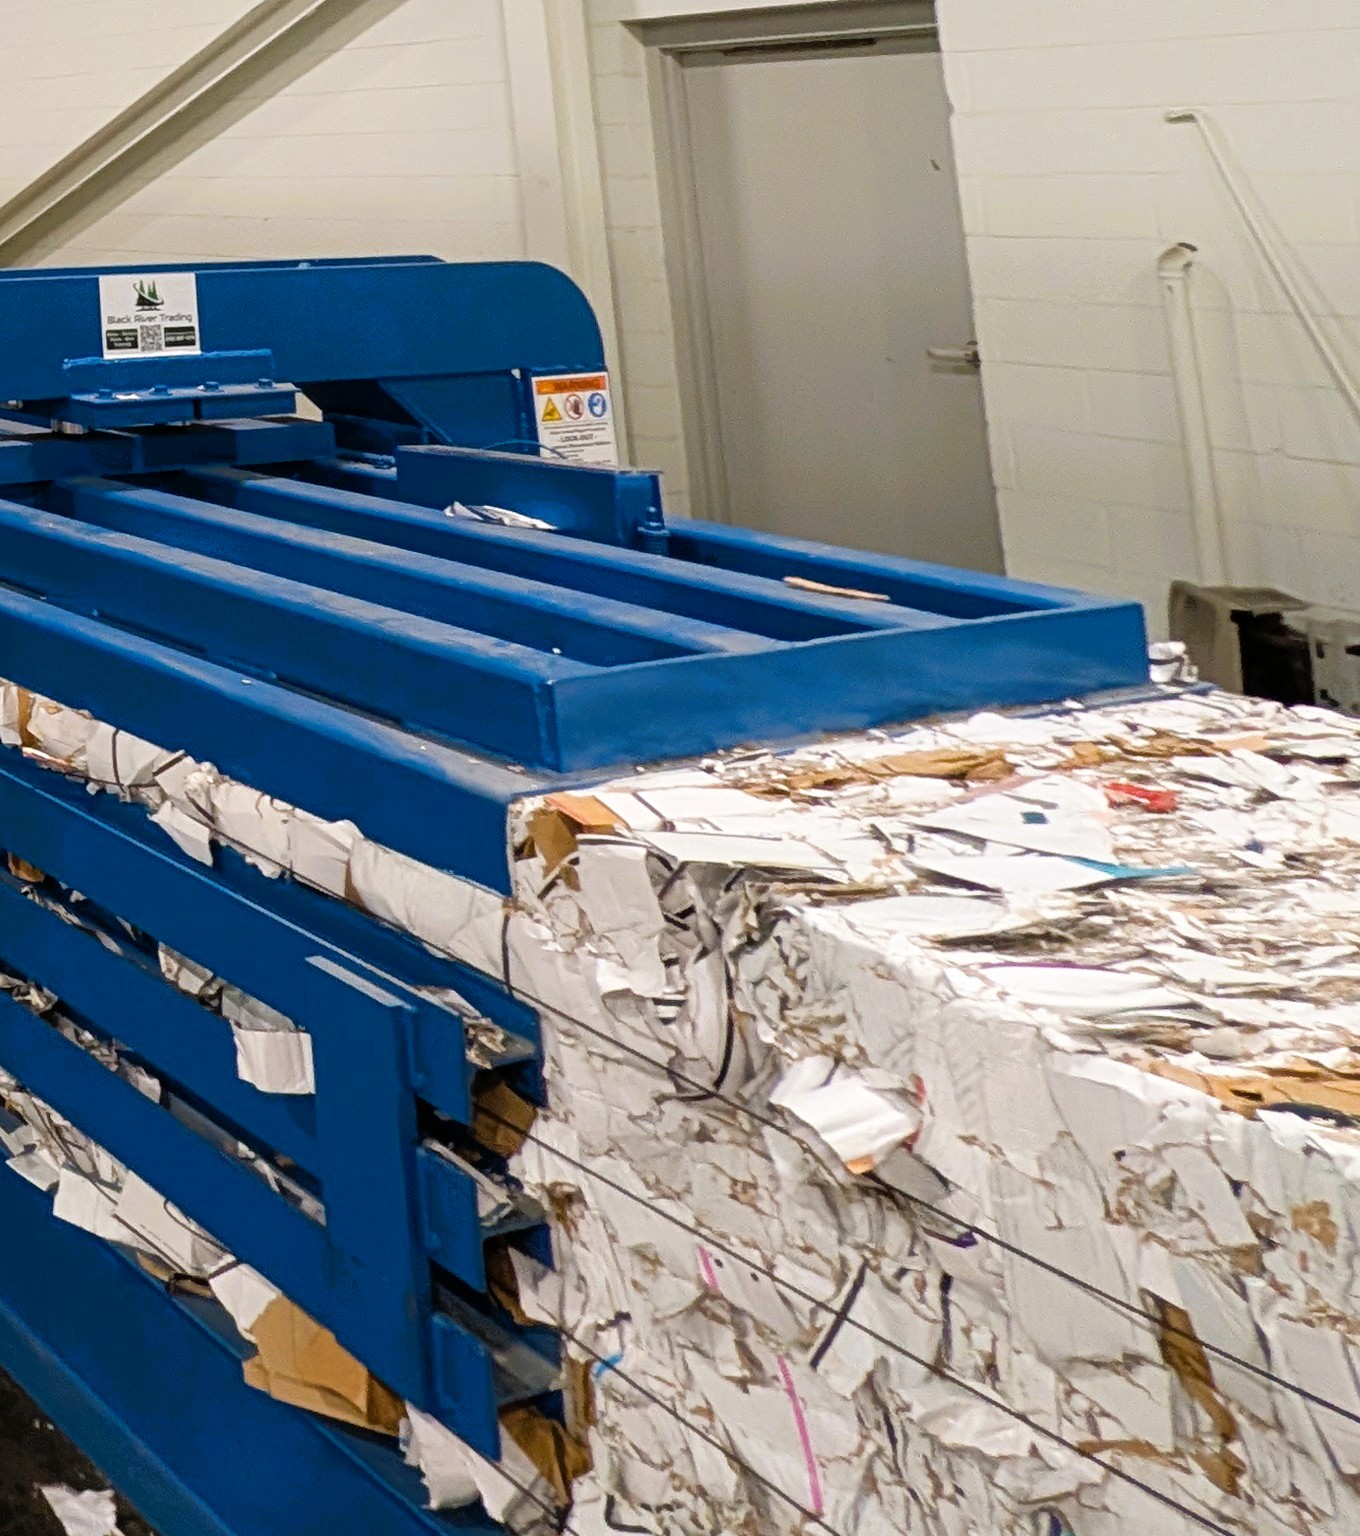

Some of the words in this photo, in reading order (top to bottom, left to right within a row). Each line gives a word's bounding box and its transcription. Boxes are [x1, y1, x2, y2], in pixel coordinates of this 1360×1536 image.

[107, 315, 132, 324] Black
[134, 314, 157, 323] River
[159, 312, 192, 323] Trading
